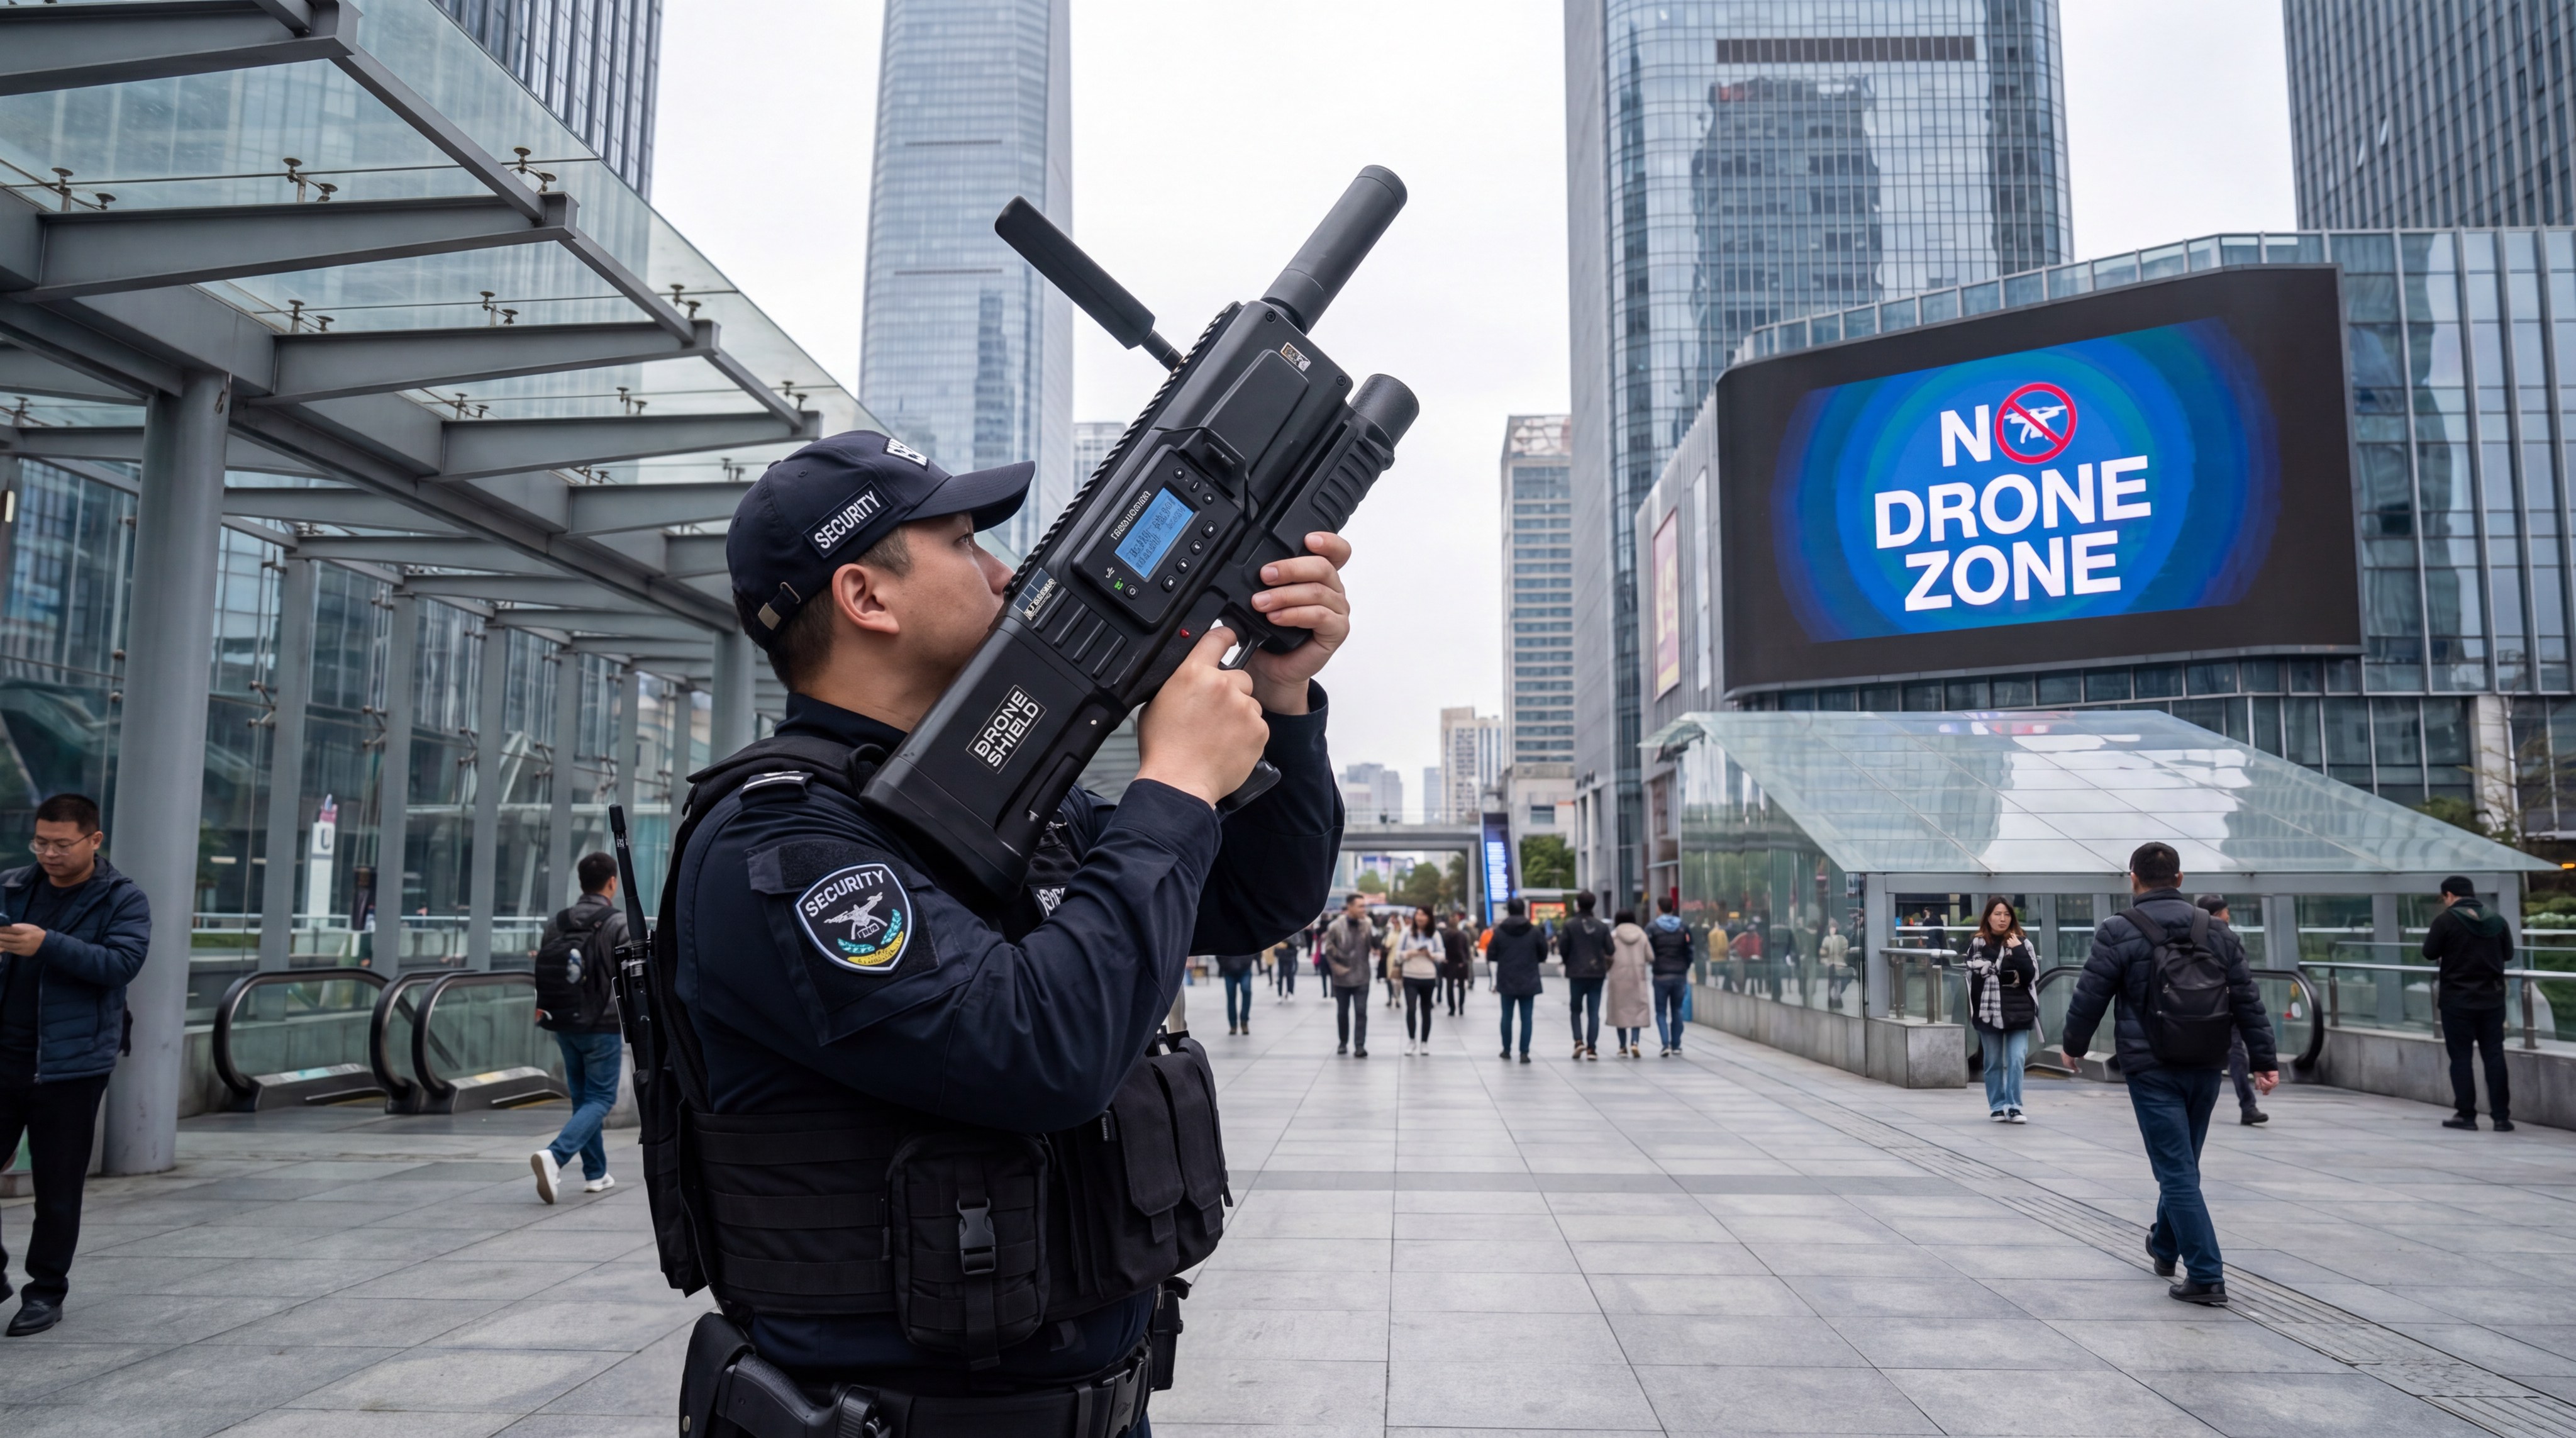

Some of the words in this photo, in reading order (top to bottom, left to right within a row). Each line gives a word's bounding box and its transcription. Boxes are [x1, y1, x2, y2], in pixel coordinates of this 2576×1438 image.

[814, 490, 881, 549] SECURITY
[1874, 455, 2151, 549] DRONE
[1904, 530, 2121, 611] ZONE
[987, 702, 1039, 767] SHIELD
[805, 870, 883, 918] SECURITY
